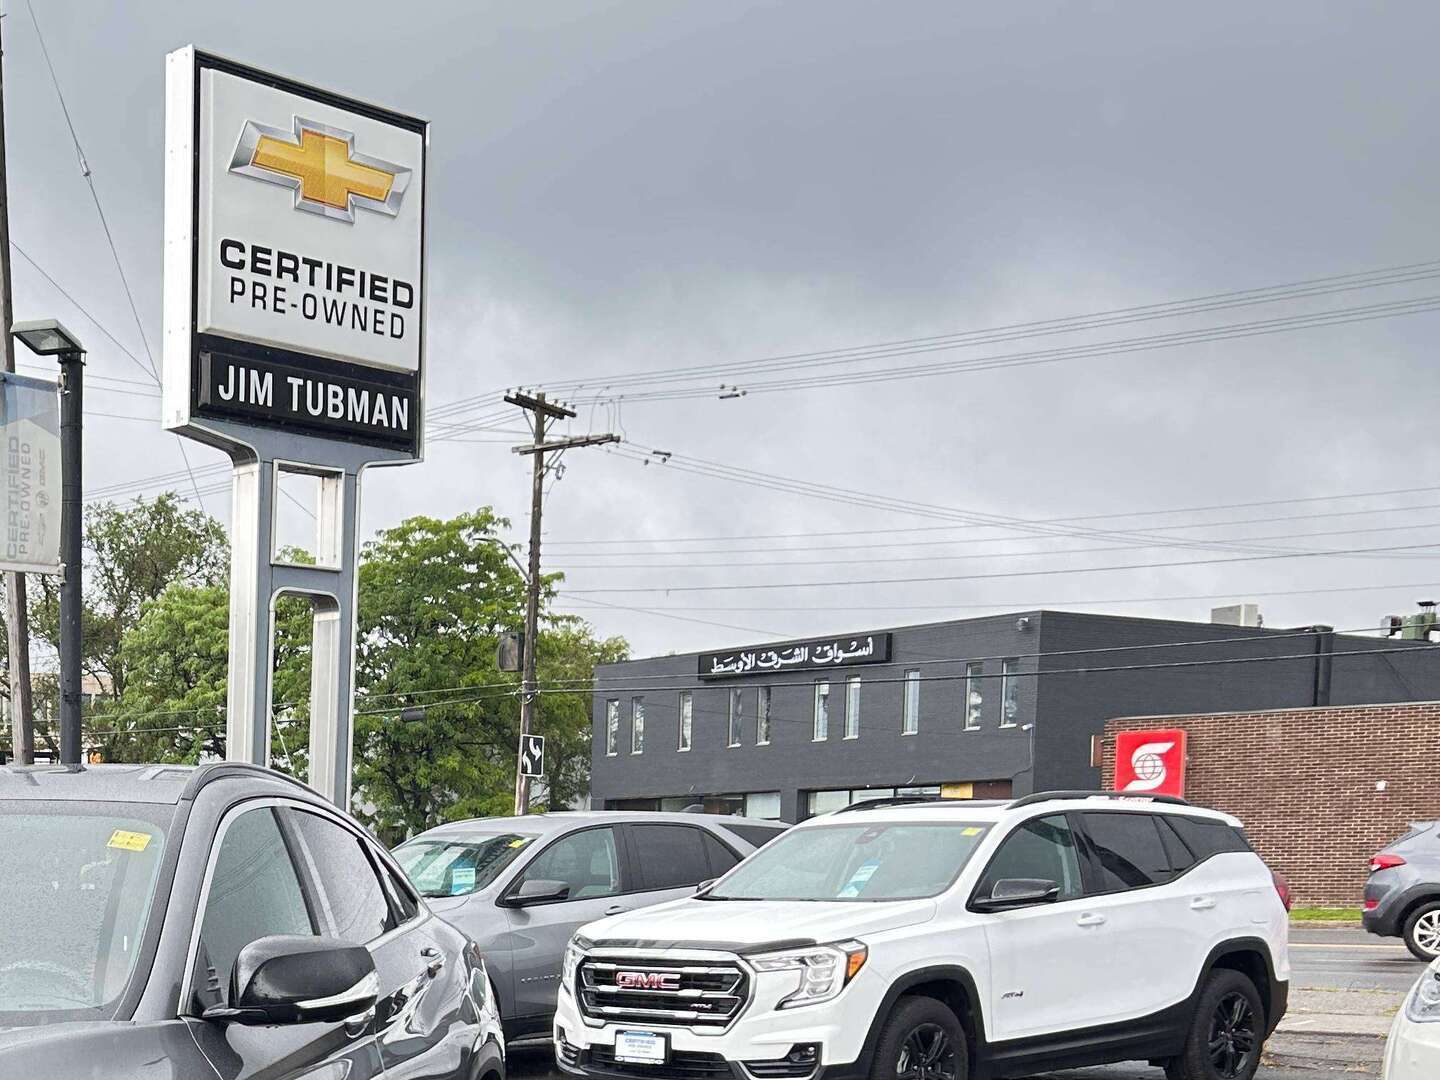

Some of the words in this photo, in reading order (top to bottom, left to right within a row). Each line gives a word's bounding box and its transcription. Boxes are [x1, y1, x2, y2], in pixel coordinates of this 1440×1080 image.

[220, 238, 414, 309] CERTIFIED
[230, 276, 405, 340] PRE-OWNED
[218, 365, 273, 408] JIM
[287, 377, 409, 431] TUBMAN
[7, 436, 20, 560] CERTIFIED
[19, 442, 31, 555] PRE-OWNED
[616, 971, 681, 989] GMC
